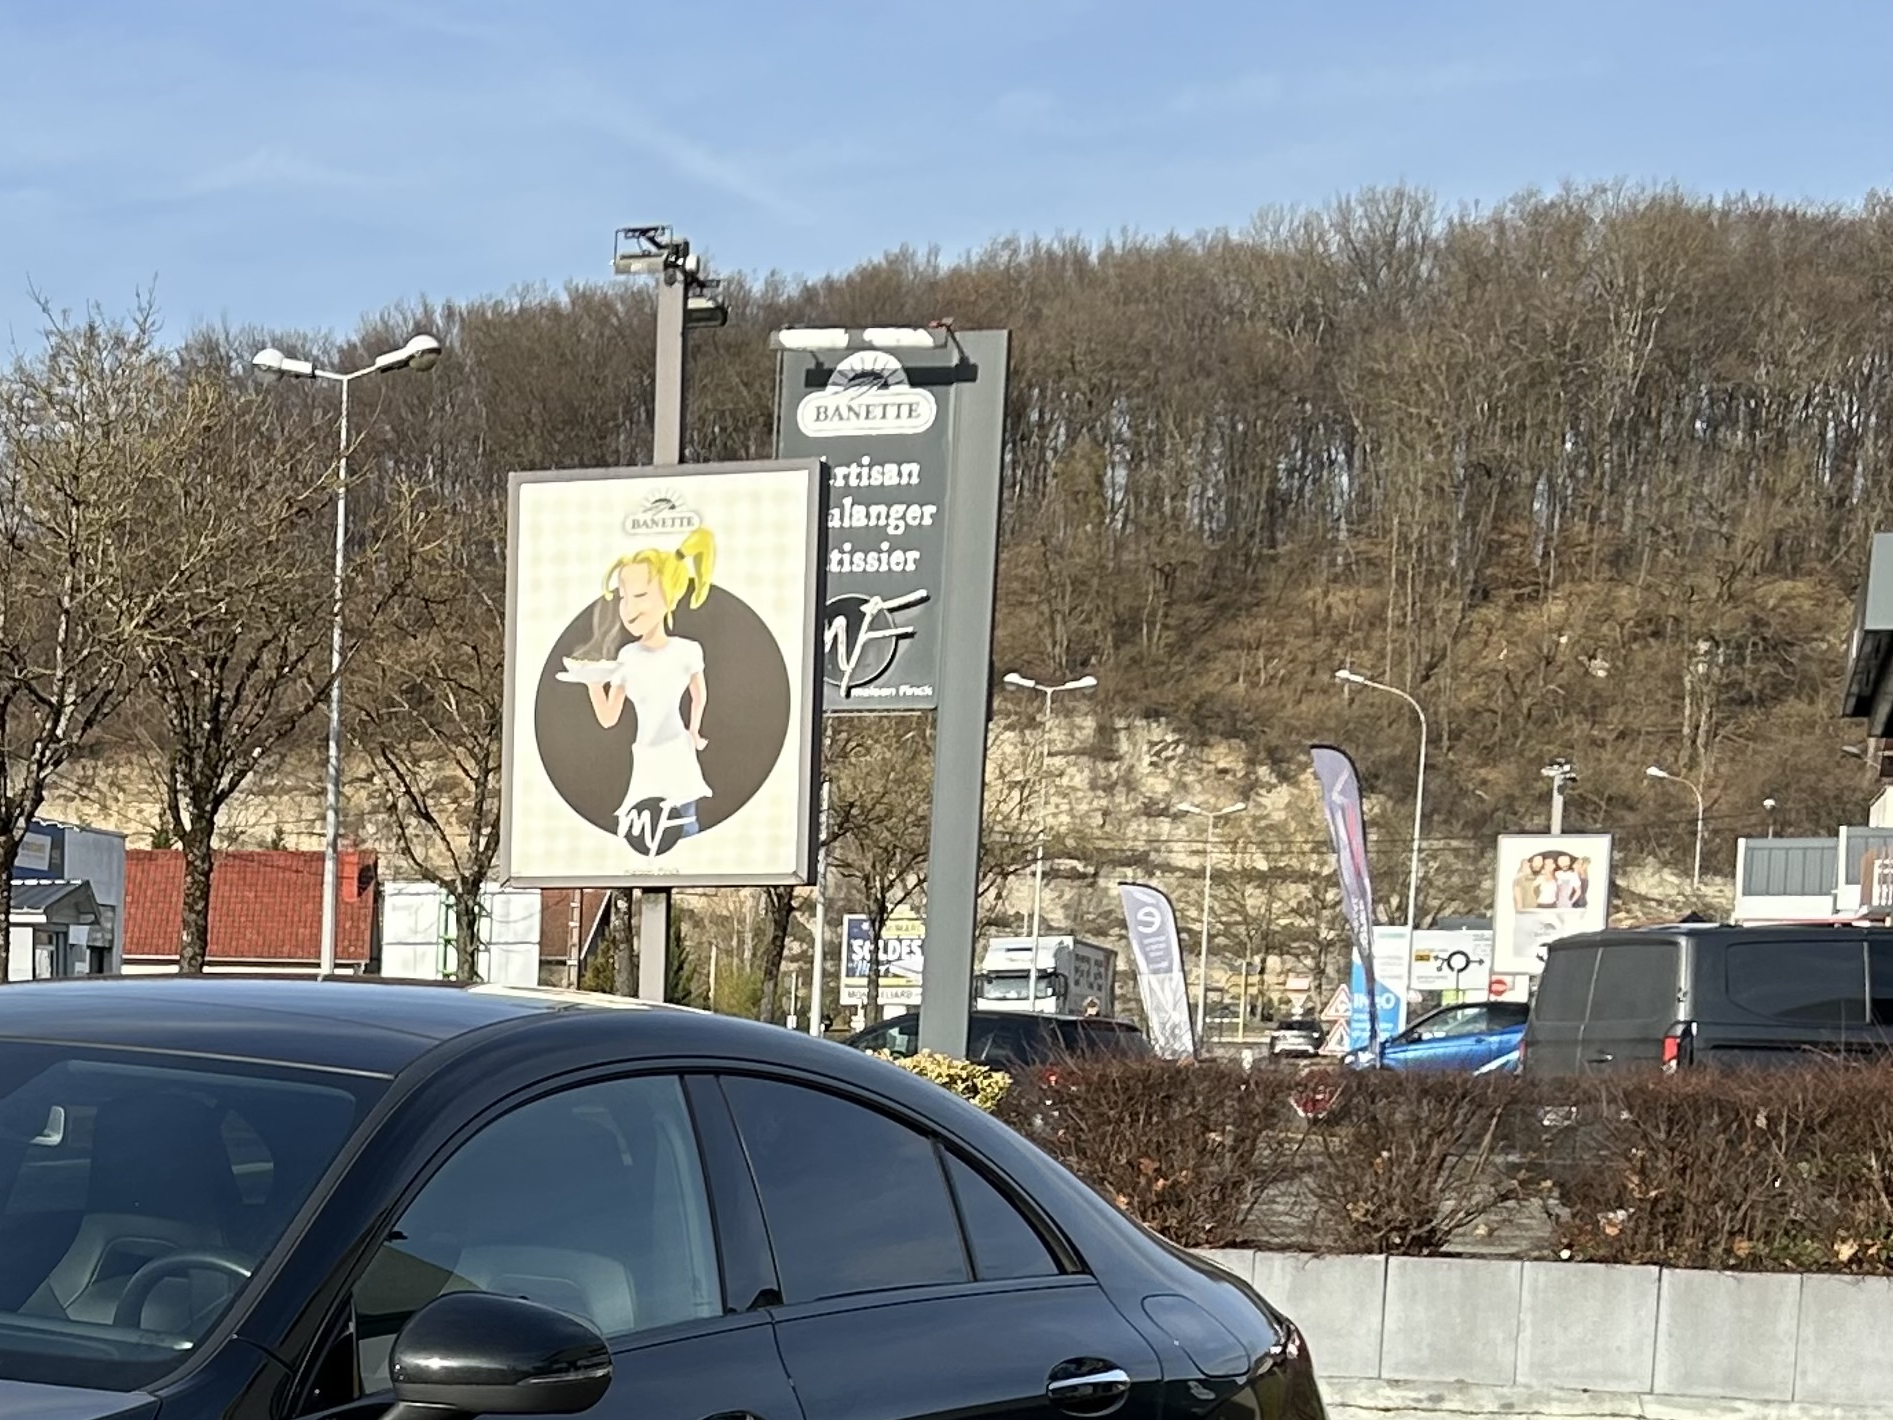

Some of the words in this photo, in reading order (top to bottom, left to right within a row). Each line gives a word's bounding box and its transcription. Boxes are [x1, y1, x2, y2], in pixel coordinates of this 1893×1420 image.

[814, 402, 921, 422] BANETTE
[821, 456, 920, 487] rtisan
[631, 516, 695, 529] BANETTE
[828, 496, 937, 535] ulanger
[827, 541, 920, 572] tissier
